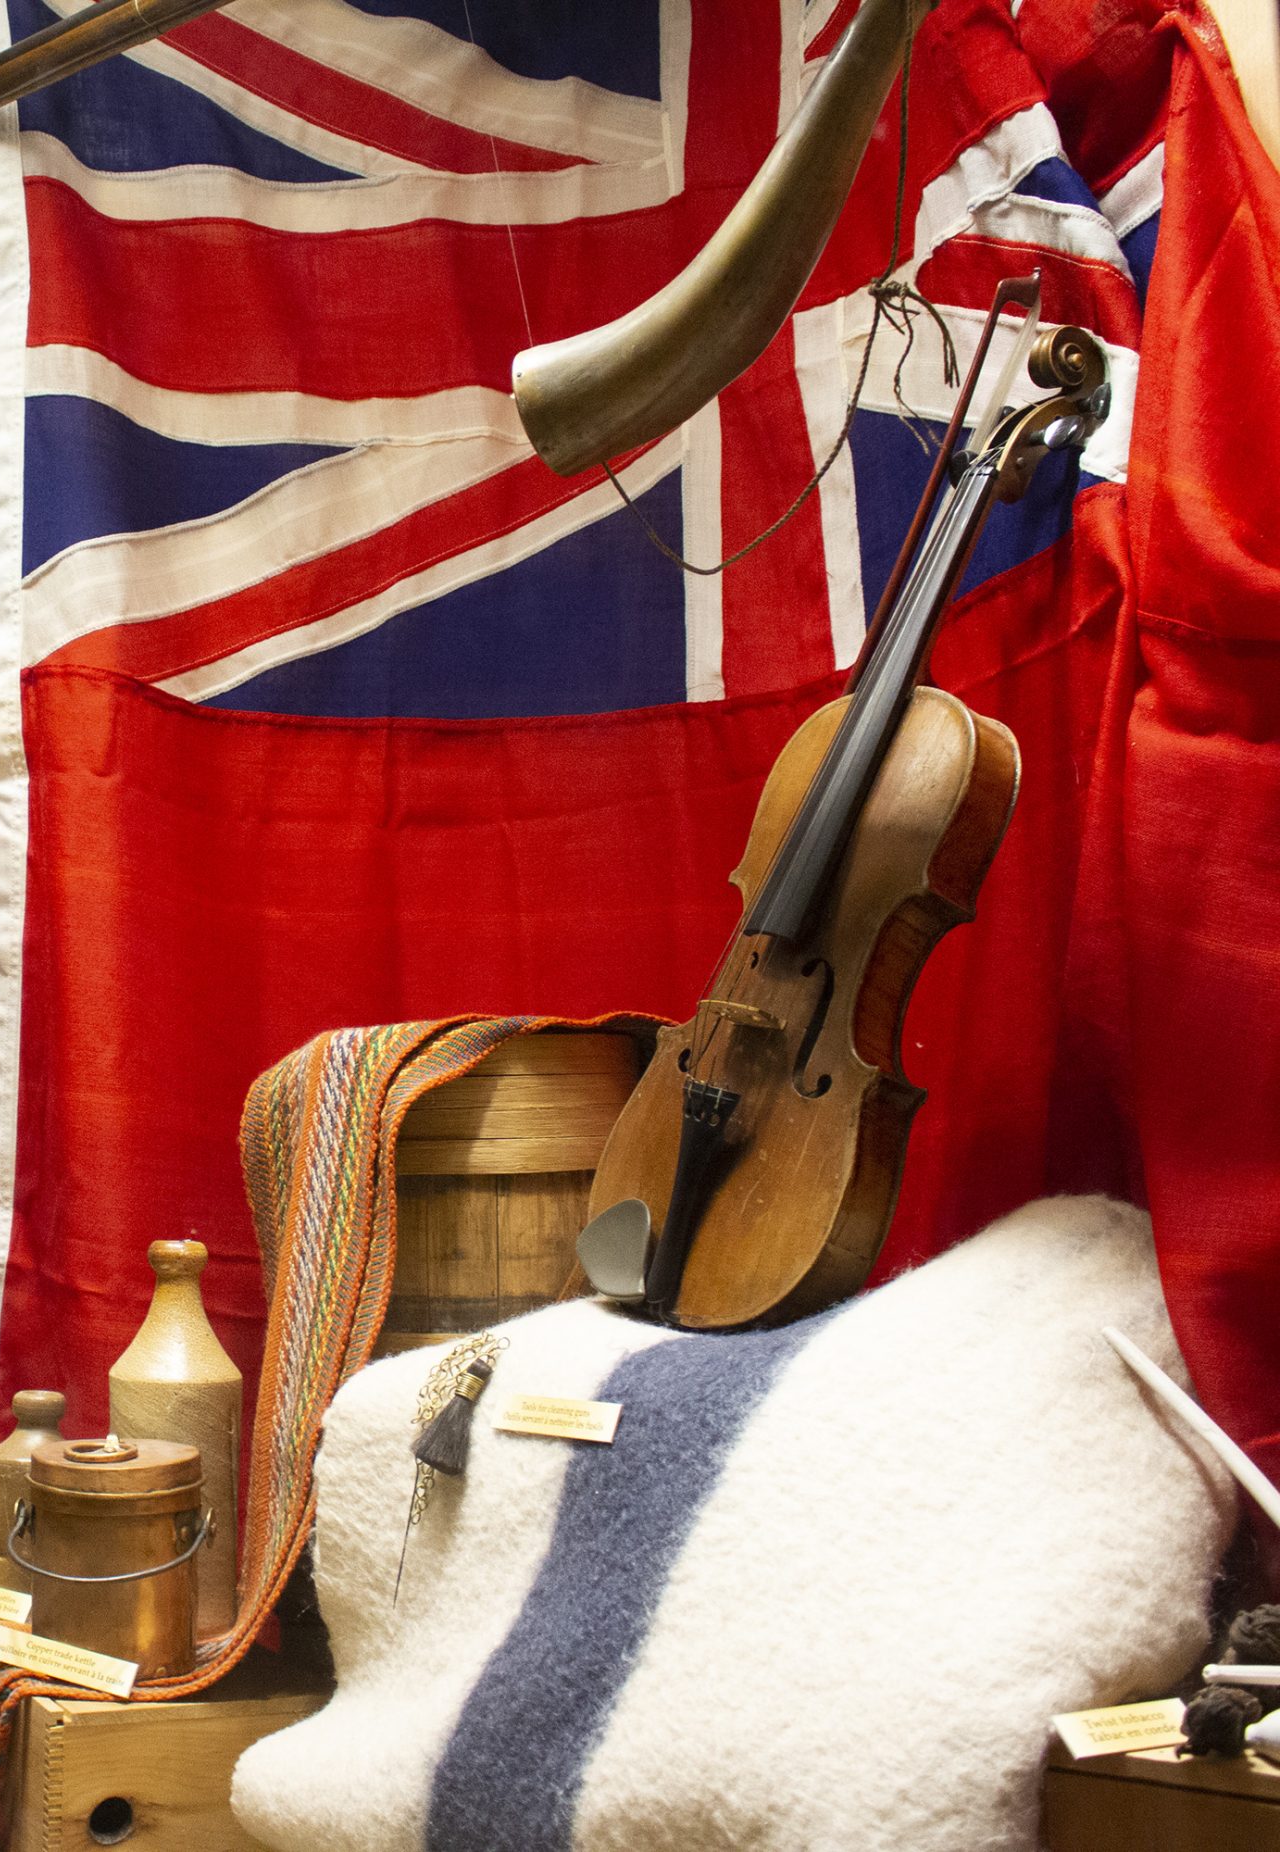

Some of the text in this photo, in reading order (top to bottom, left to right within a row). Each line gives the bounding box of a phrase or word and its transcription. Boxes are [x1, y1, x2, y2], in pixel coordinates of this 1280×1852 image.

[26, 1640, 97, 1667] Copper trade kettle
[28, 1653, 38, 1662] en
[38, 1656, 62, 1668] cuivre
[63, 1663, 90, 1677] servant
[97, 1671, 105, 1682] la
[1083, 1712, 1165, 1729] Twist tobacco
[1089, 1723, 1177, 1743] Tabac en corde
